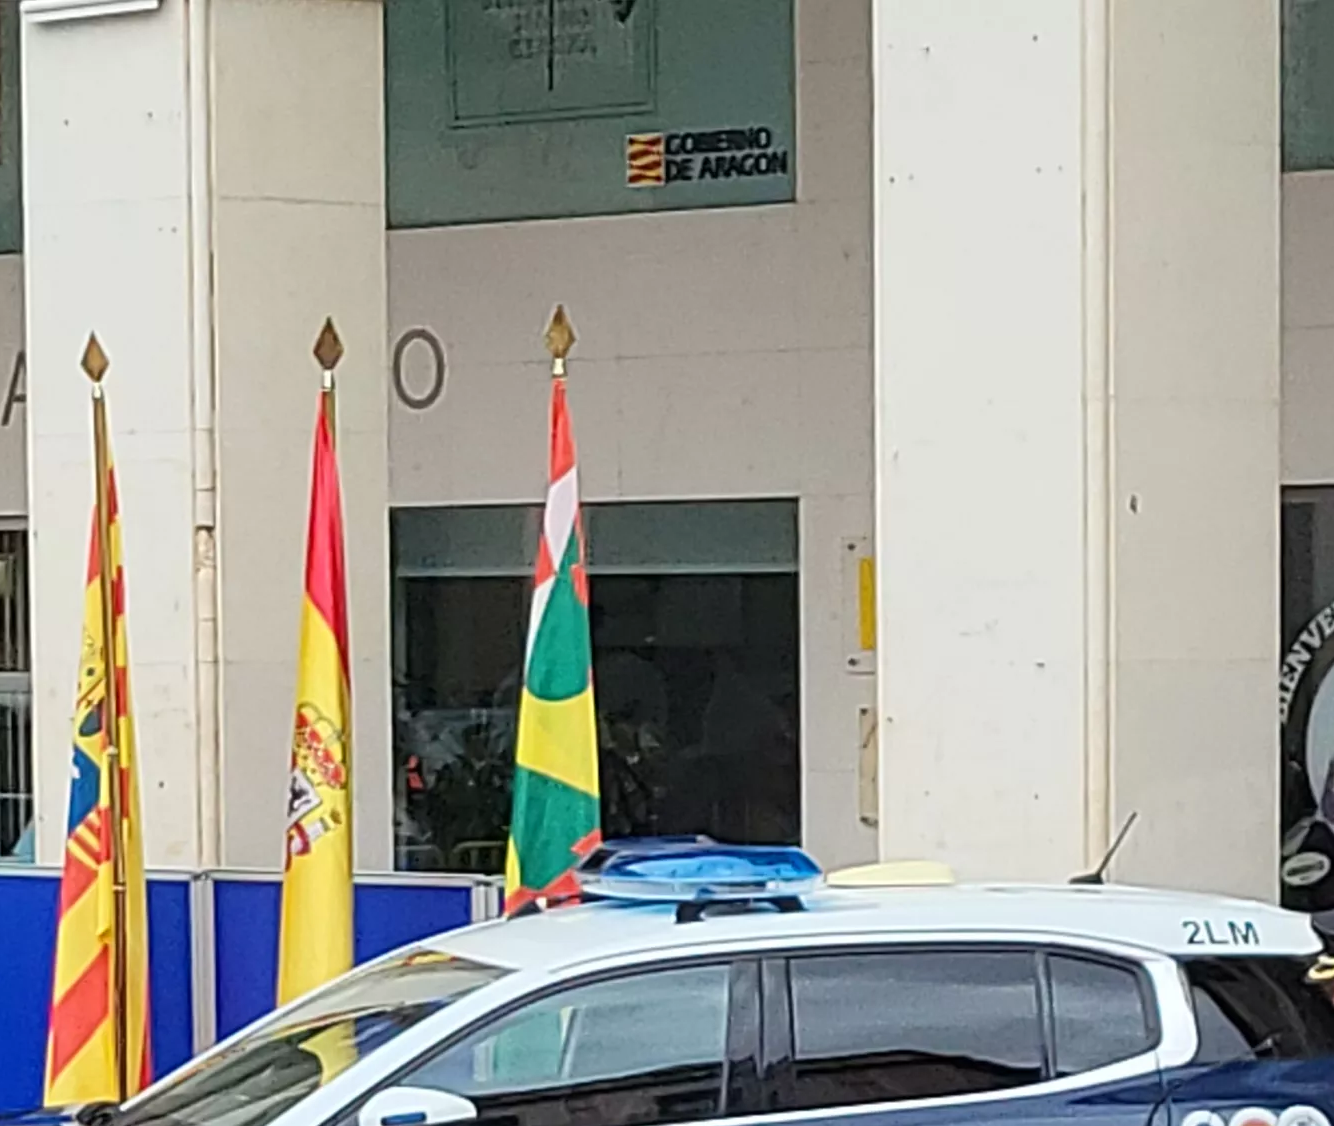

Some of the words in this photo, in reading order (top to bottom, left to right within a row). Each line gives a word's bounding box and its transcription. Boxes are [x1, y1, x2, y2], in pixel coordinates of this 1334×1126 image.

[666, 126, 771, 155] GOBIERNO
[666, 158, 693, 182] DE
[1182, 920, 1260, 945] 2LM
